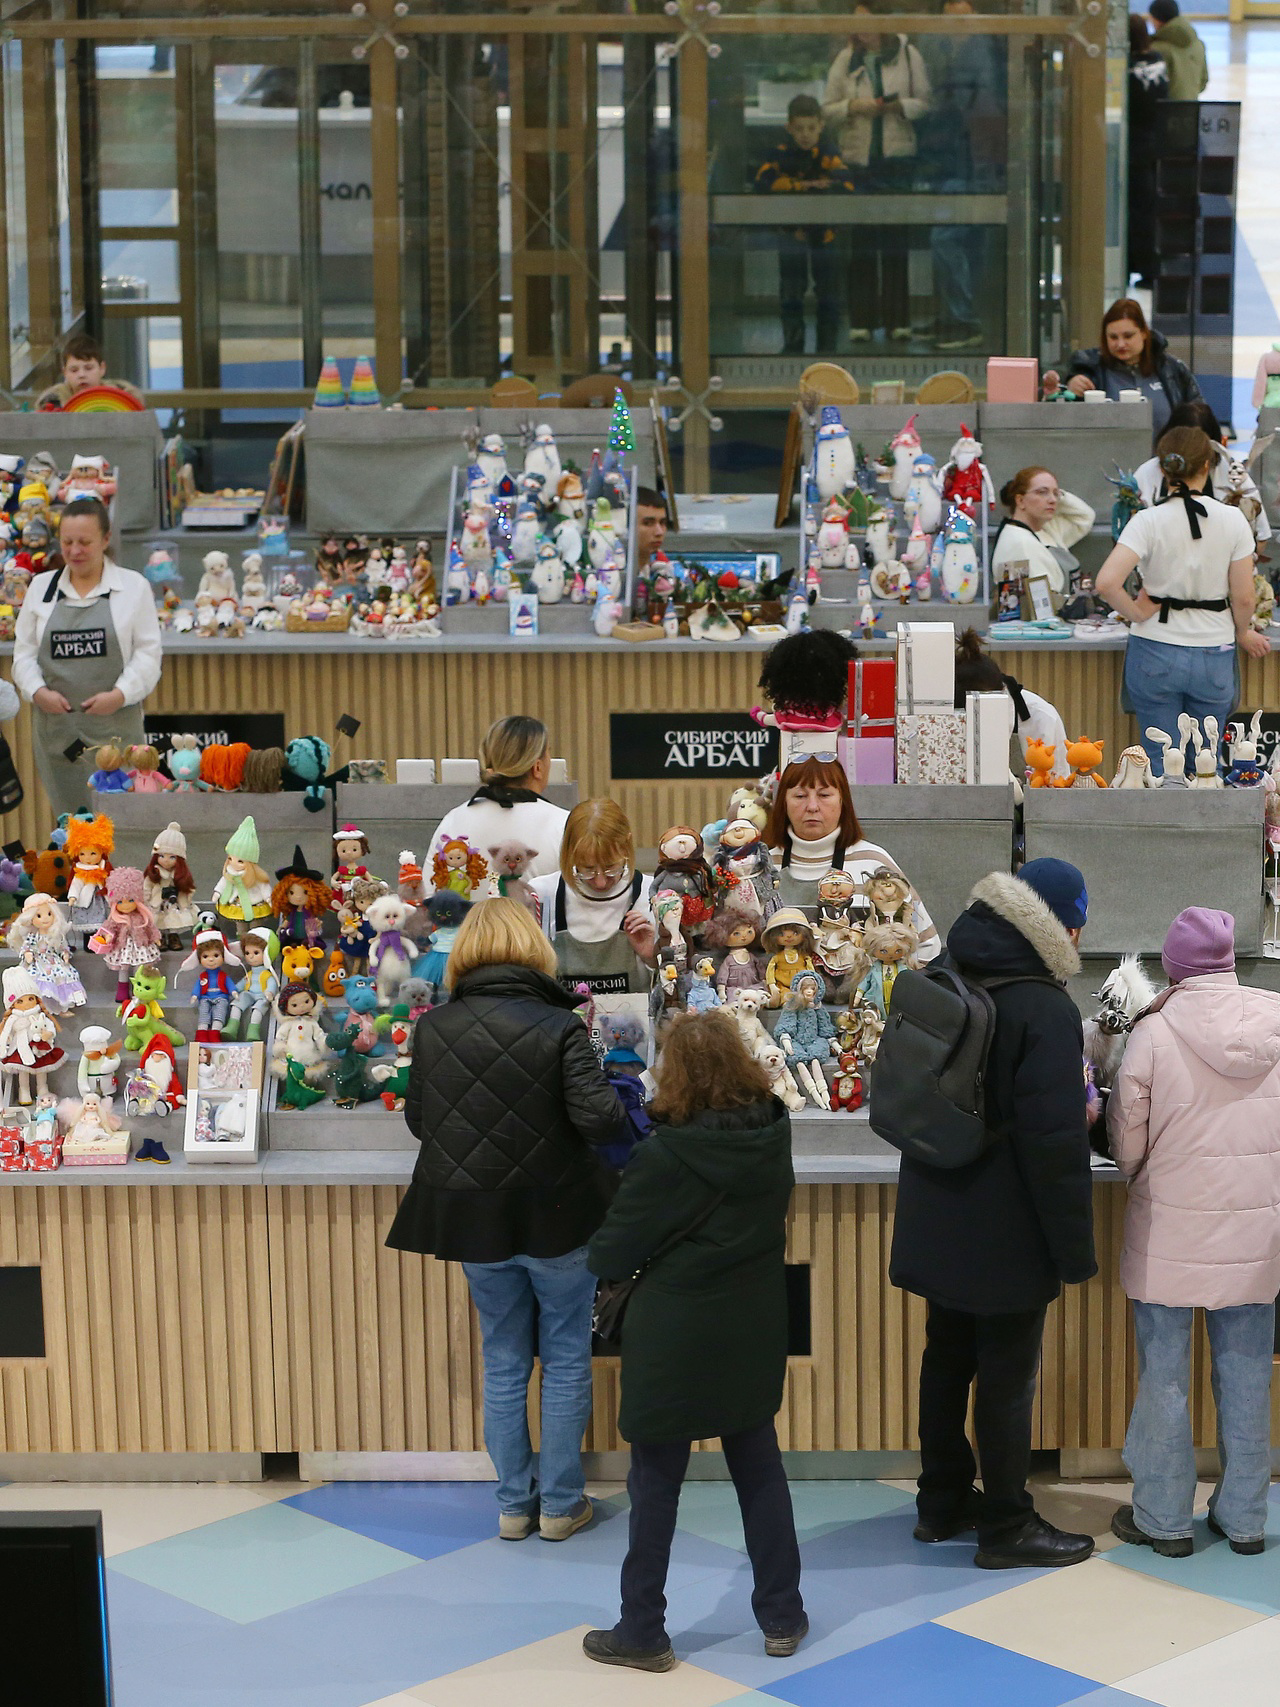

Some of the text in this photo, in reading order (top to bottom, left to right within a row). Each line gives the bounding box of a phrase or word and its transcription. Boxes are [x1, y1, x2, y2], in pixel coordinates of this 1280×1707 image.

[53, 641, 103, 656] АРБАТ
[664, 729, 770, 745] СИБИРСКИЙ
[664, 743, 767, 768] АРБАТ
